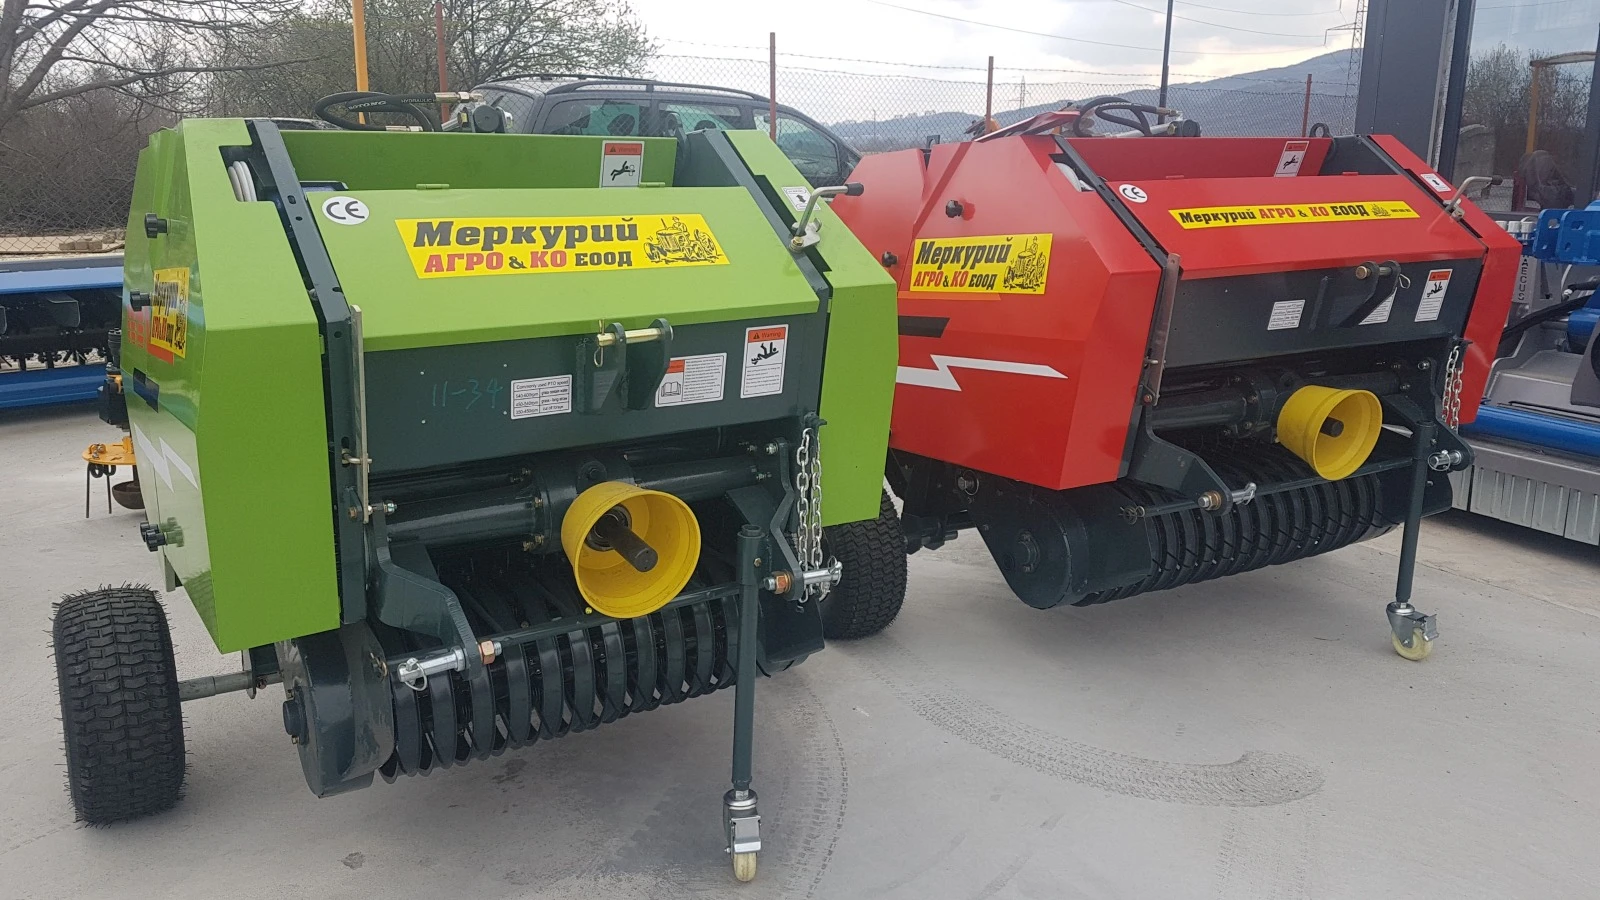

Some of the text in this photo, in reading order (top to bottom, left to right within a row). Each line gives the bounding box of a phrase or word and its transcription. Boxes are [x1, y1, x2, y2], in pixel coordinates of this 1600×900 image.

[1122, 187, 1146, 199] CE
[326, 200, 365, 220] CE
[1178, 204, 1370, 224] Меркурий АГРО & КО ЕООД
[413, 217, 638, 251] Меркурий
[424, 250, 633, 273] АГРО & КО ЕООД
[915, 237, 1012, 270] Меркурий
[913, 270, 997, 290] АГРО & КО ЕООД
[432, 378, 503, 410] 11-34
